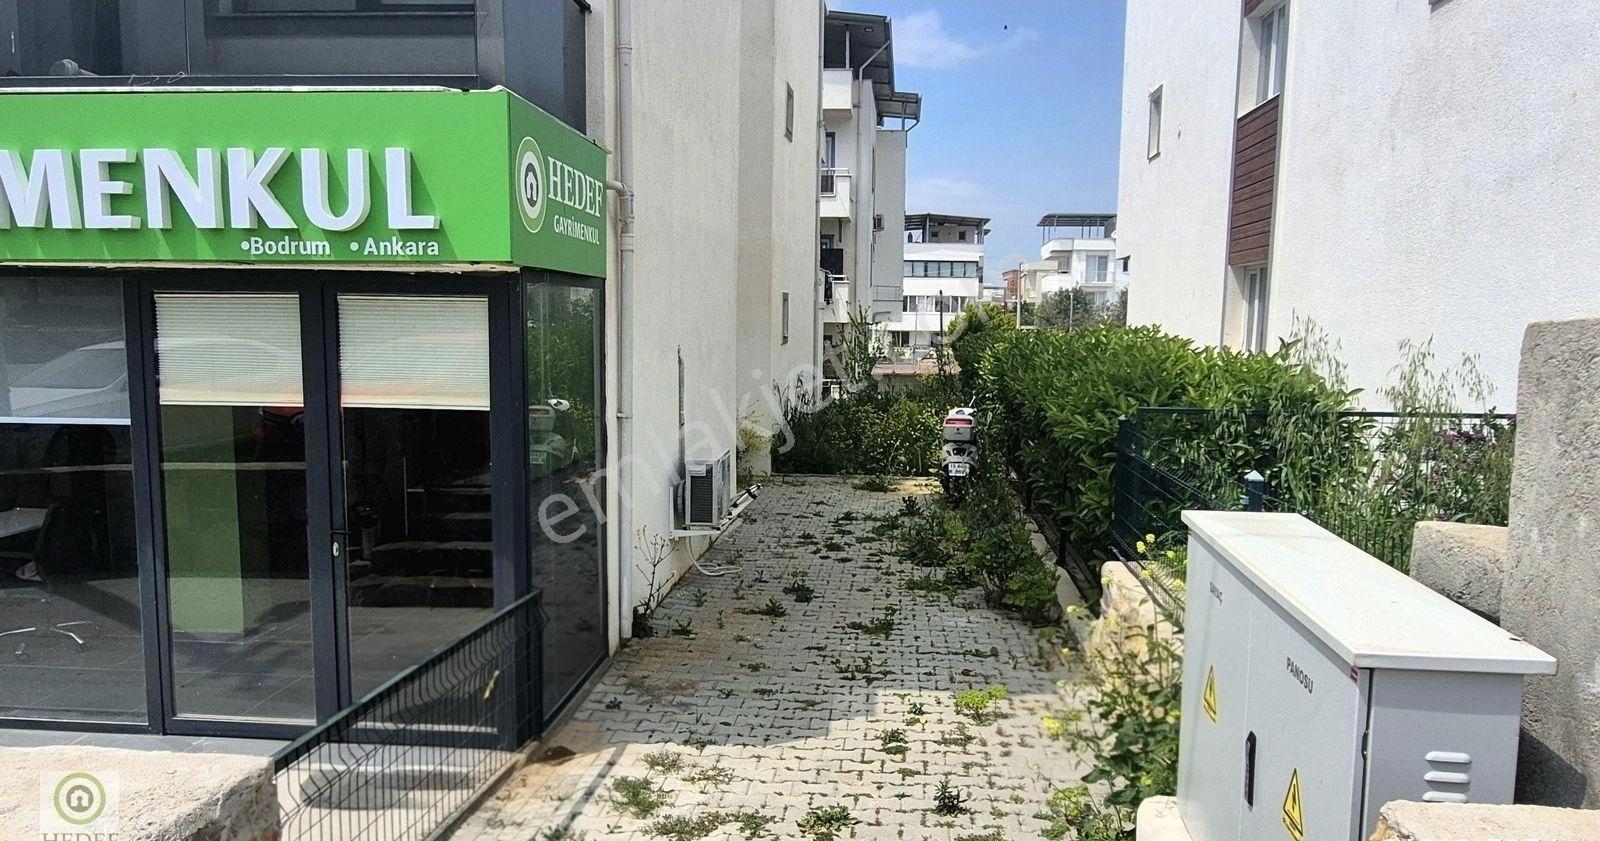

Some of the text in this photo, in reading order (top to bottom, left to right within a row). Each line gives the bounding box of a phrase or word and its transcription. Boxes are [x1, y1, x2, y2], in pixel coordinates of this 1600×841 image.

[0, 147, 440, 231] MENKUL
[547, 156, 603, 217] HEDEF
[363, 238, 439, 256] Ankara
[554, 215, 600, 245] GAYRİMENKUL
[1286, 656, 1314, 692] PANOSU
